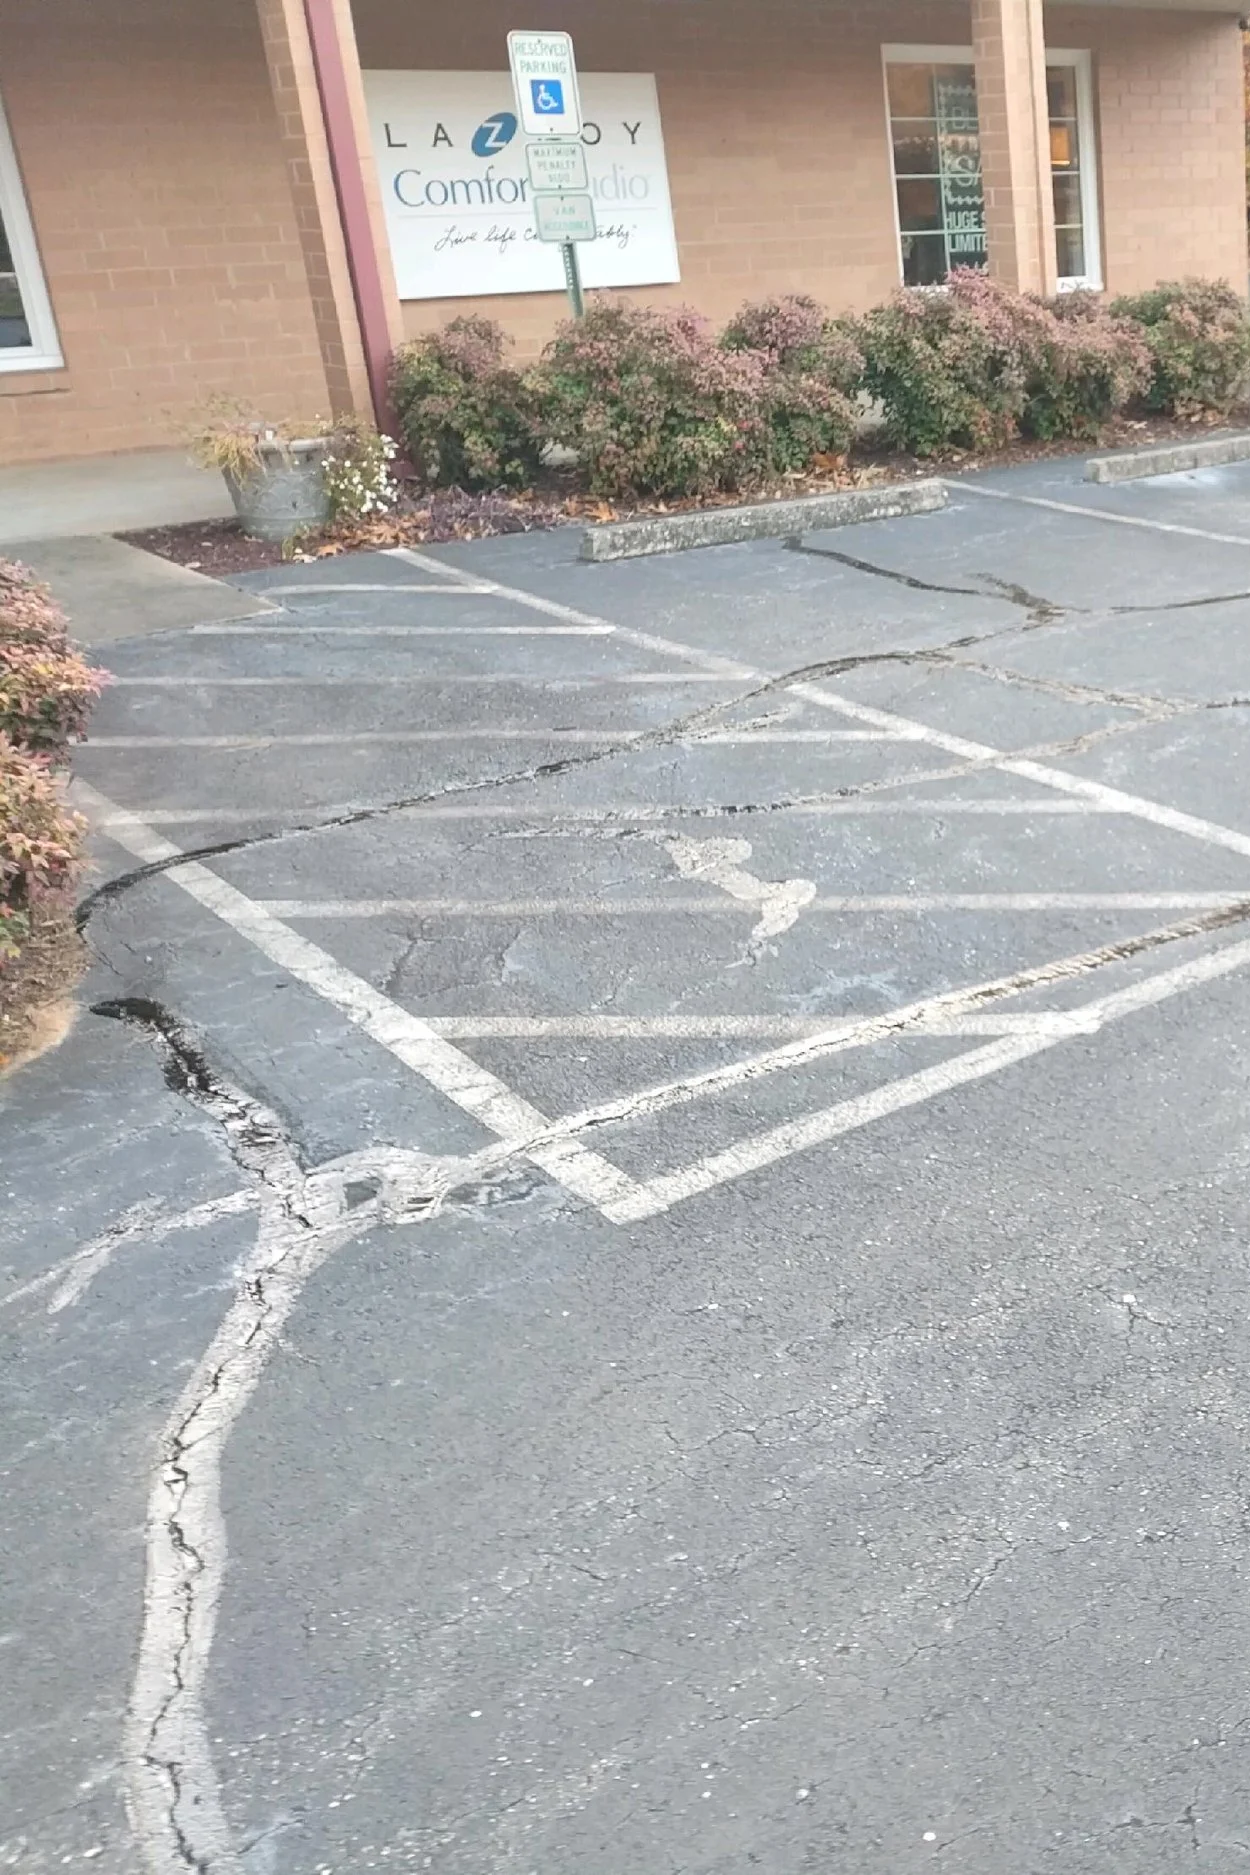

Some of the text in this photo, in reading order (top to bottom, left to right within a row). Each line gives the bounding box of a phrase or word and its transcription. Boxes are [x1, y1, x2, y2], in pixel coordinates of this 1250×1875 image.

[515, 42, 567, 56] RESERVED
[520, 59, 567, 73] PARKING
[537, 160, 576, 170] PENALTY
[393, 165, 528, 207] Comfor
[553, 206, 576, 215] VAN
[944, 211, 978, 229] HUGE
[483, 224, 516, 254] life
[948, 233, 988, 252] LIMITE
